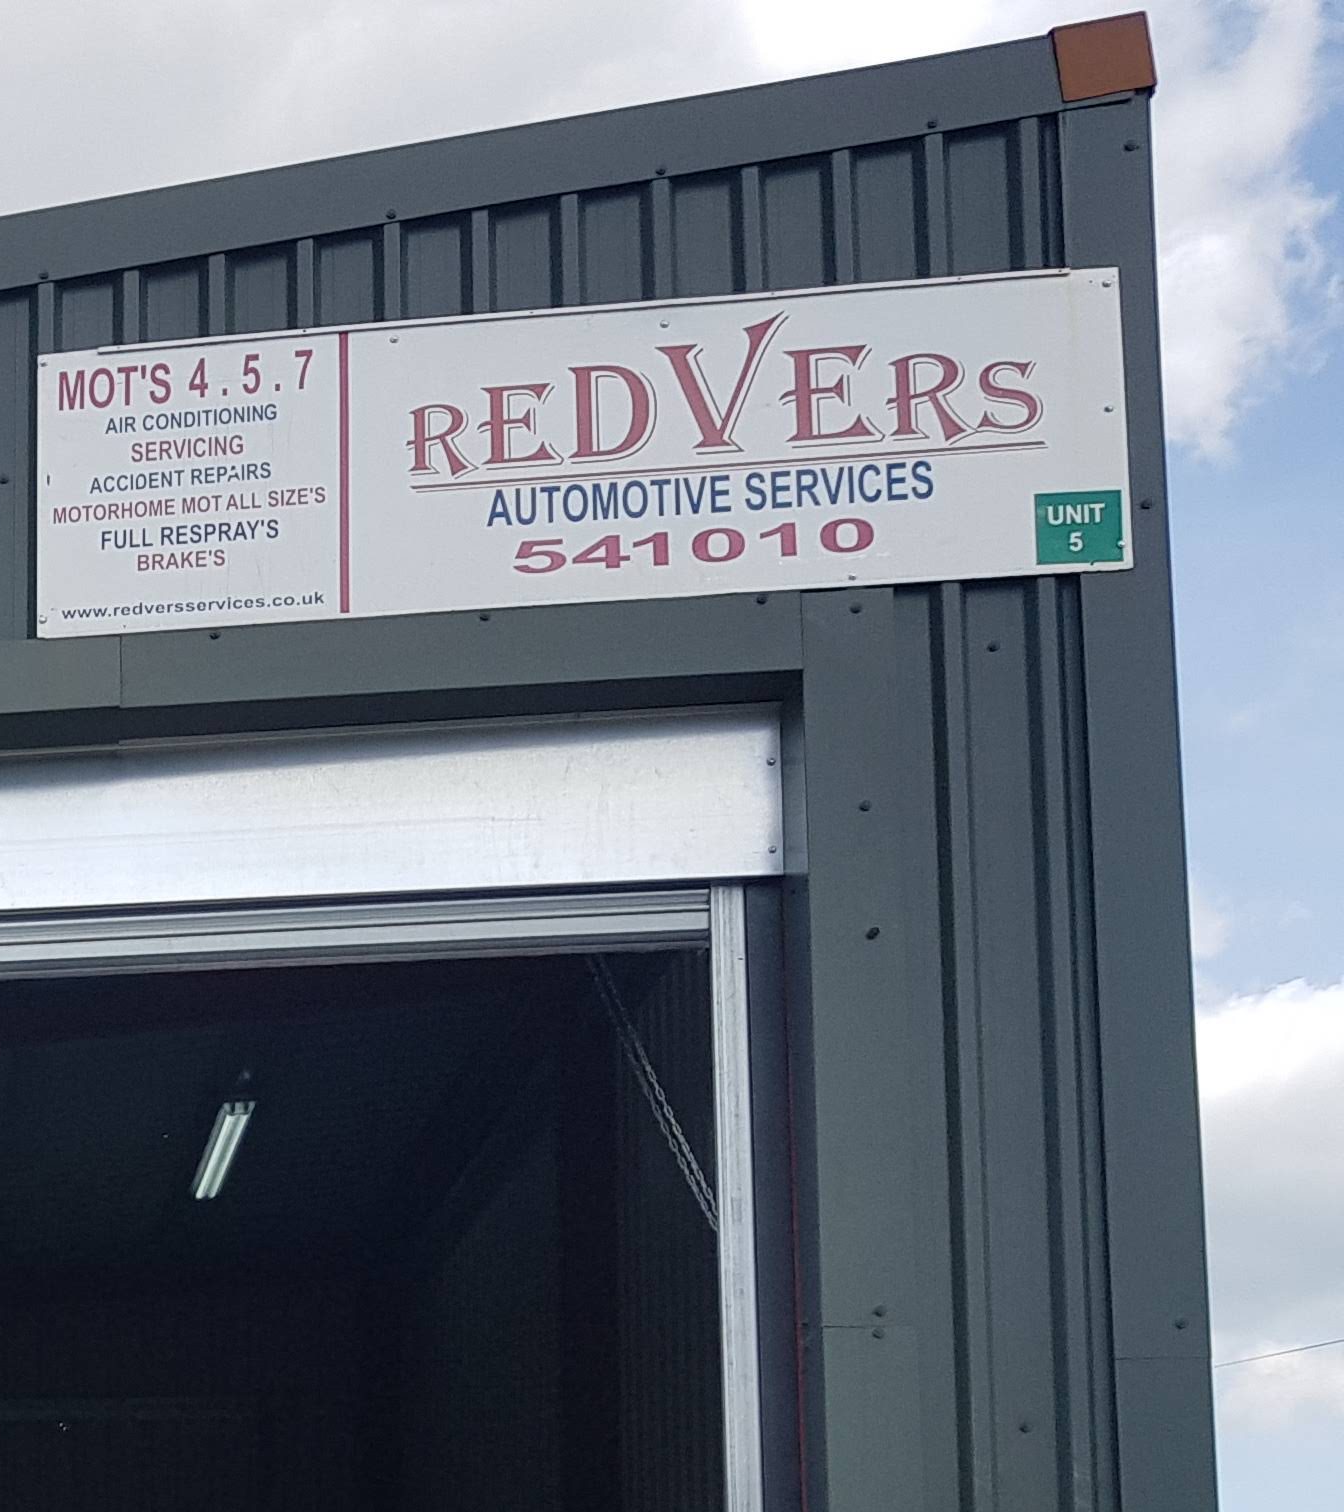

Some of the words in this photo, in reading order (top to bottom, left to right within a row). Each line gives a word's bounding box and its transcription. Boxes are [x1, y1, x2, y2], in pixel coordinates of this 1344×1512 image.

[58, 361, 172, 411] MOT'S
[104, 415, 137, 434] AIR
[142, 403, 278, 432] CONDITIONING
[130, 434, 244, 463] SERVICING
[89, 469, 185, 494] ACCIDENT
[190, 462, 272, 486] REPAIRS
[486, 474, 732, 527] AUTOMOTIVE
[744, 460, 934, 512] SERVICES
[52, 498, 176, 524] MOTORHOME
[181, 494, 223, 514] MOT
[225, 492, 262, 512] ALL
[267, 486, 326, 508] SIZE'S
[1046, 503, 1106, 525] UNIT
[100, 529, 154, 550] FULL
[160, 518, 280, 546] RESPRAY'S
[512, 517, 875, 574] 541010
[1069, 530, 1084, 552] 5
[136, 549, 226, 572] BRAKE'S
[61, 591, 325, 620] www.redversservices.co.uk
